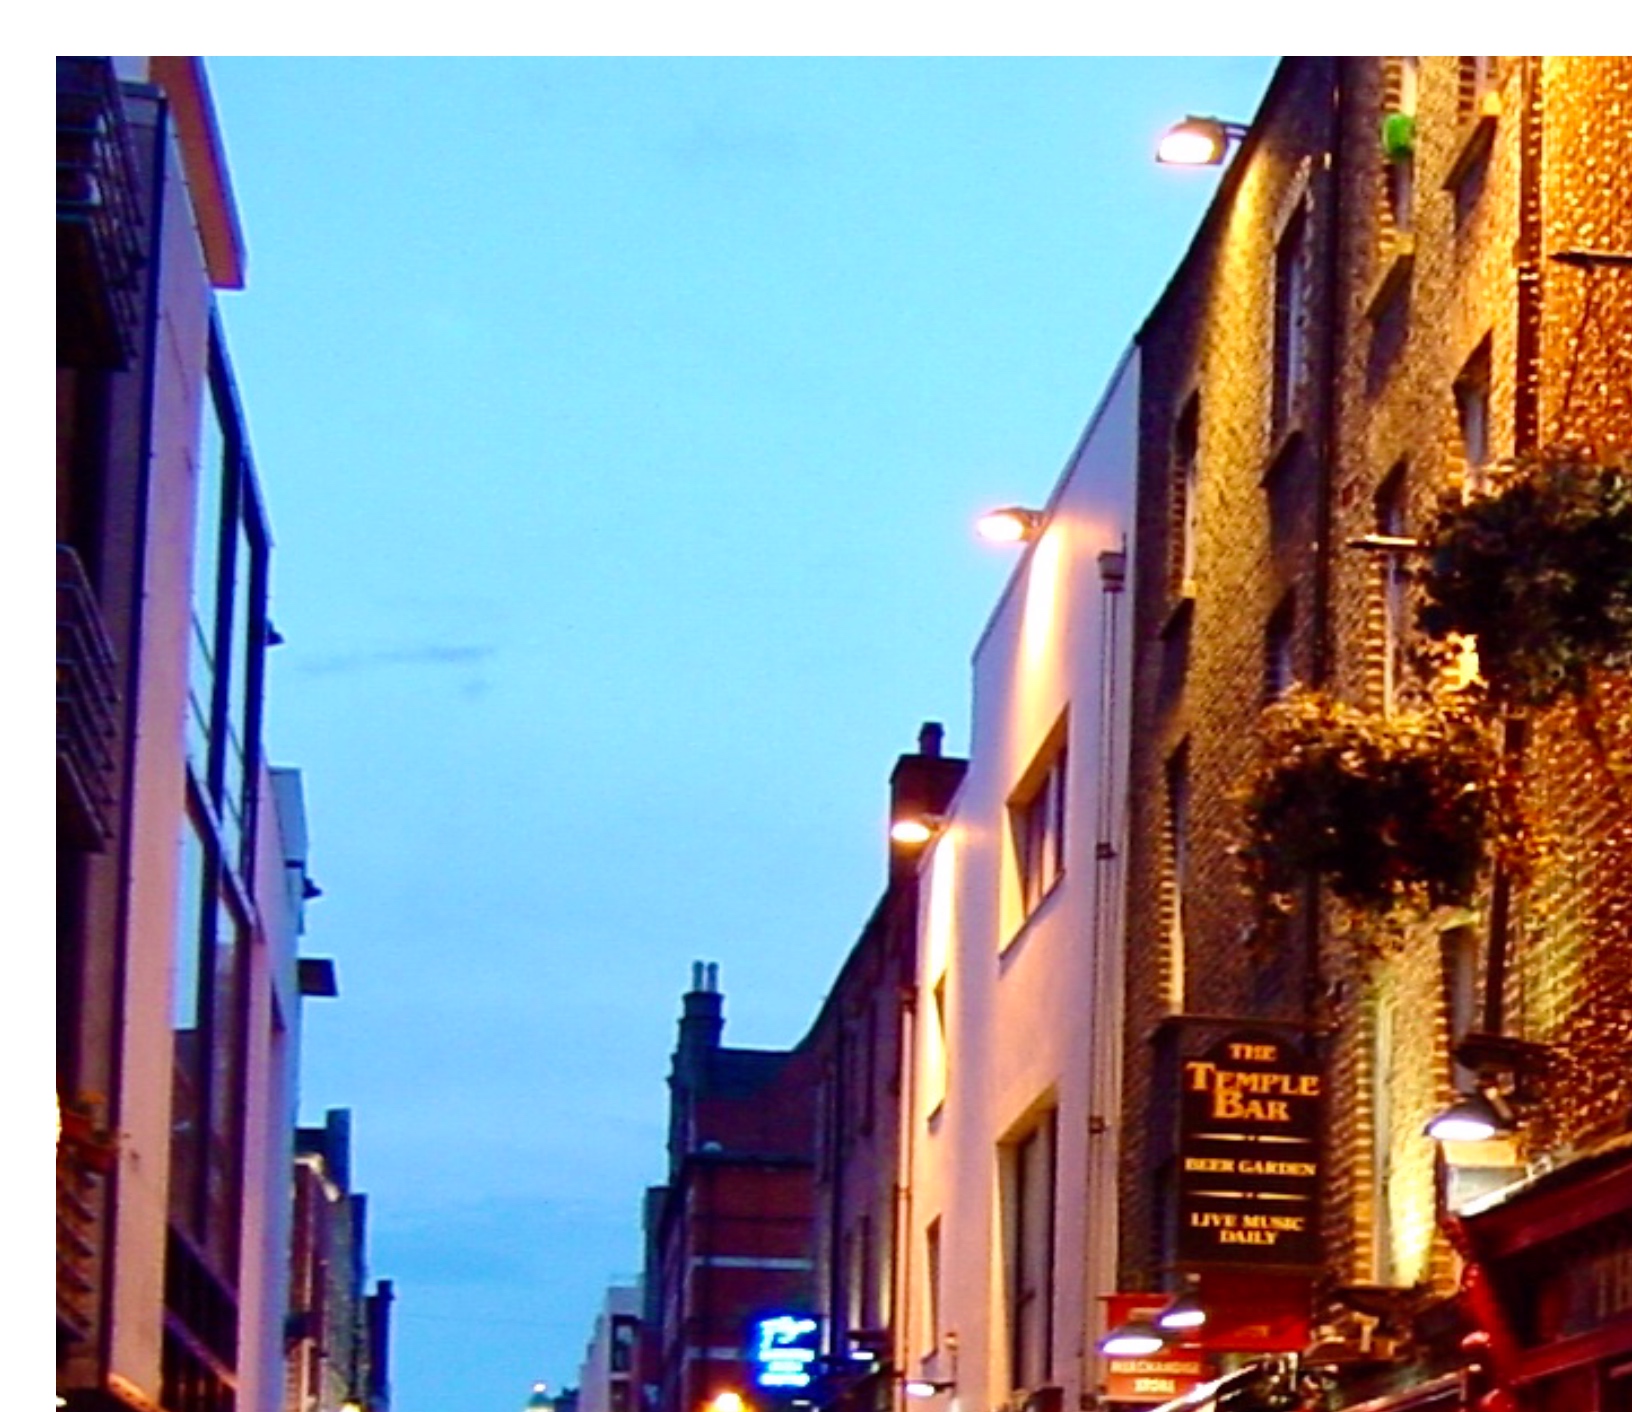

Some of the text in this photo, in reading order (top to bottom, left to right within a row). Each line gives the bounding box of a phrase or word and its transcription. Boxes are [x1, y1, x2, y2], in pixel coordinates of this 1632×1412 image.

[1229, 1043, 1277, 1061] THE
[1186, 1061, 1320, 1096] TEMPLE
[1214, 1090, 1290, 1121] BAR
[1184, 1157, 1317, 1176] BEER GARDEN
[1191, 1212, 1304, 1231] LIVE MUSIC
[1220, 1230, 1278, 1245] DAILY
